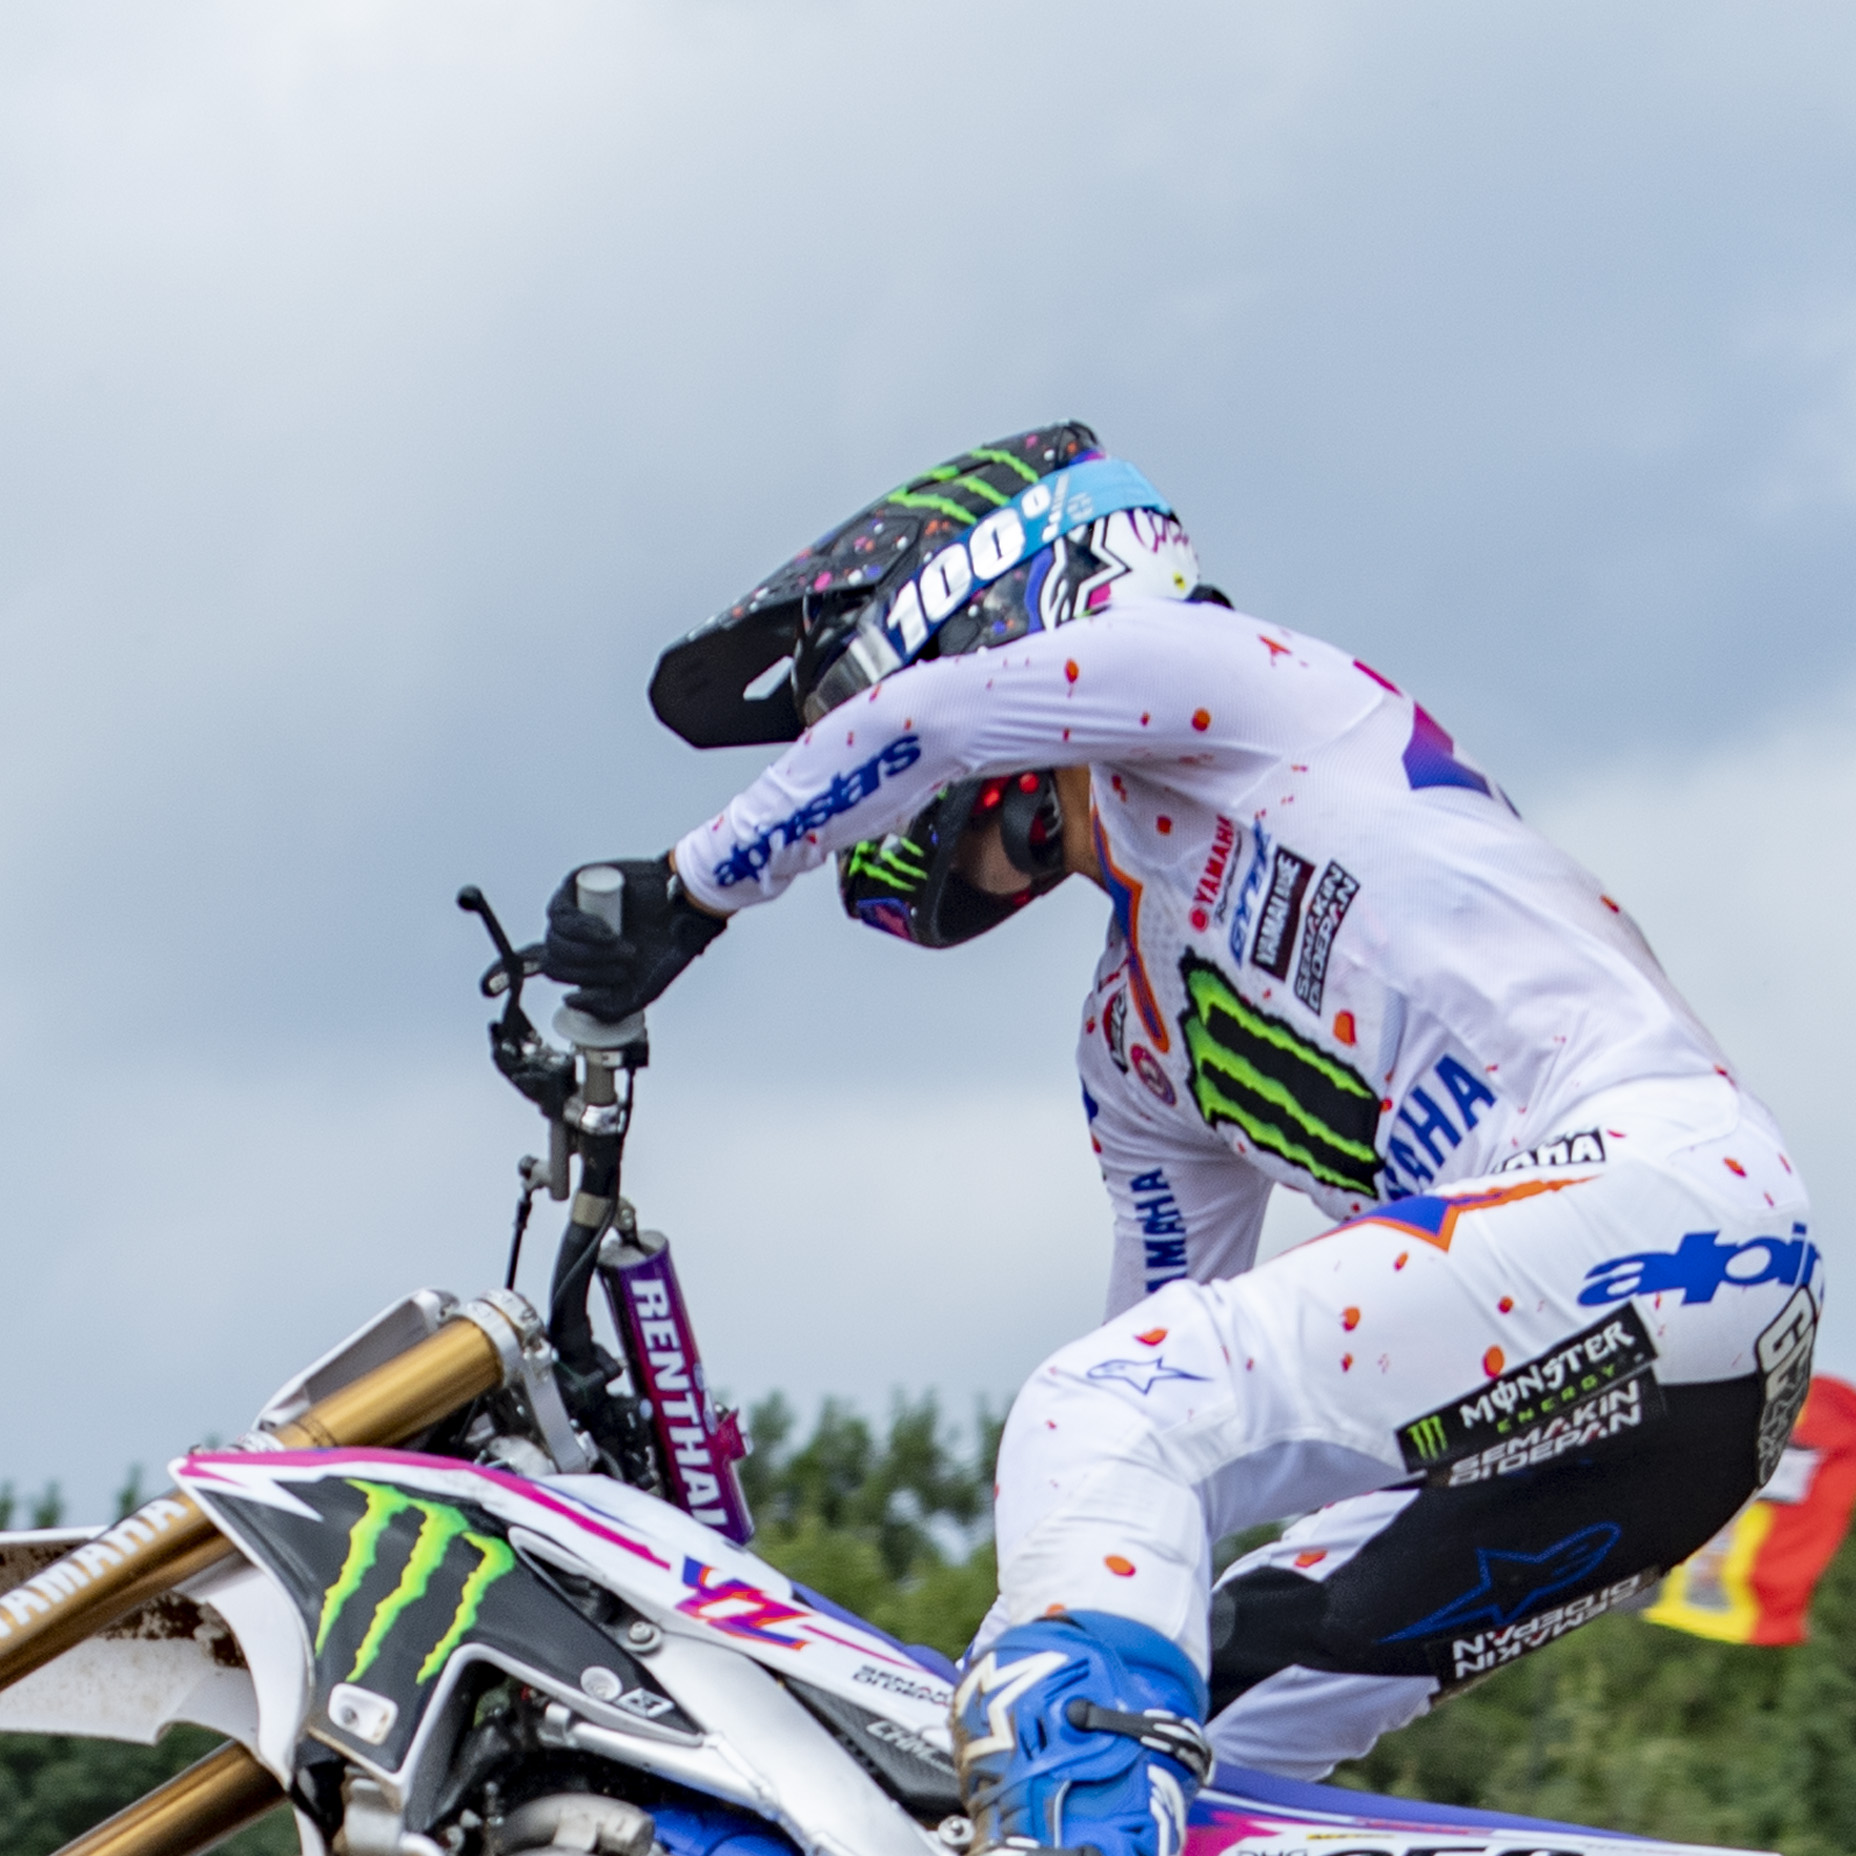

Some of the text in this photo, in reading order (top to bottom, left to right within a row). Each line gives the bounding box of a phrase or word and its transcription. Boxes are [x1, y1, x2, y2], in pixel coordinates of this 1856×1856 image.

[886, 470, 1094, 656] 100%
[1459, 1320, 1636, 1429] MONSTER
[1497, 1363, 1616, 1434] ENERGY
[1450, 1379, 1640, 1473] SEMAKIN
[1497, 1404, 1642, 1475] DEPAN
